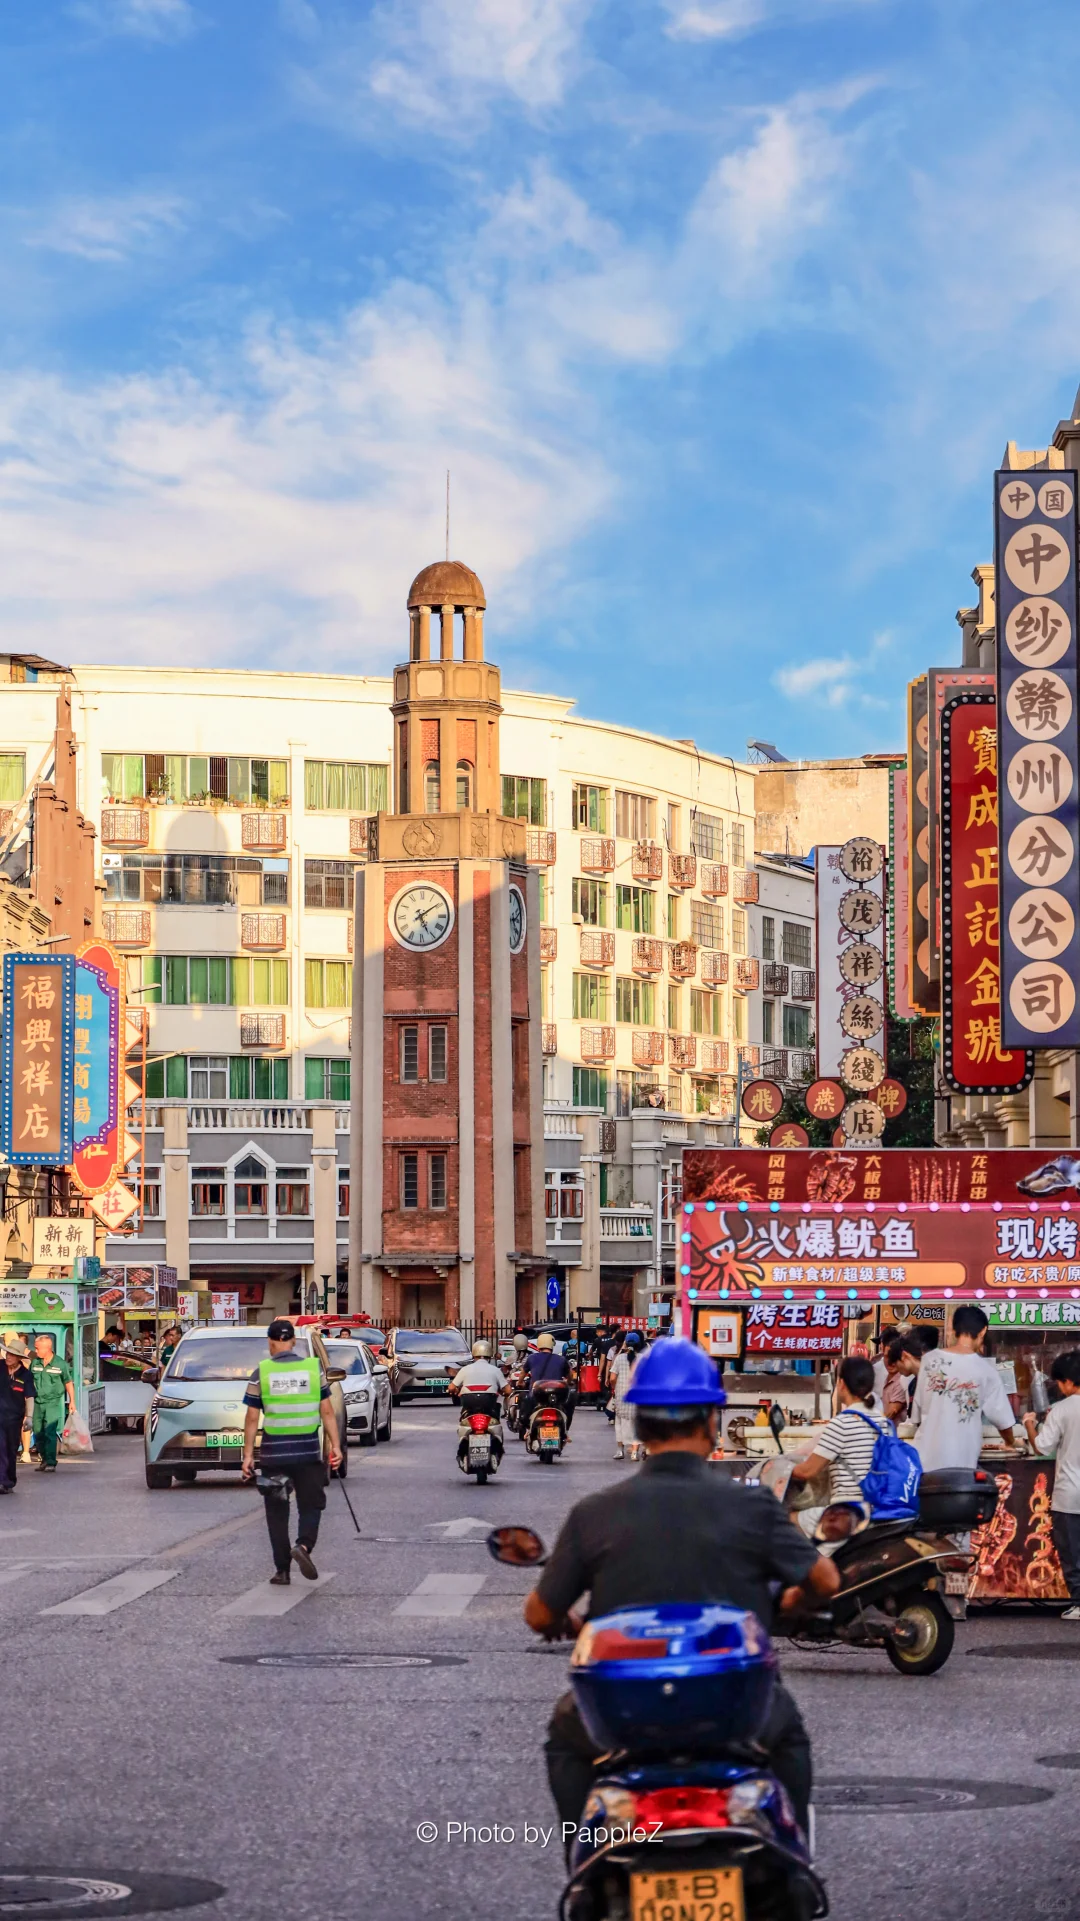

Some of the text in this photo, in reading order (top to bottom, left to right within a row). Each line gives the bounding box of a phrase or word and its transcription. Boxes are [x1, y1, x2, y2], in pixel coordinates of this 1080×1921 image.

[1008, 487, 1065, 512] 中国
[1015, 532, 1067, 1025] 中纱赣州分公司
[19, 975, 56, 1140] 福興祥店
[45, 1224, 83, 1243] 新新
[756, 1218, 918, 1258] 火爆鱿鱼
[997, 1217, 1079, 1259] 现烤
[772, 1266, 906, 1282] 新鲜食材/超级美味
[993, 1266, 1080, 1283] 好吃不贵/原
